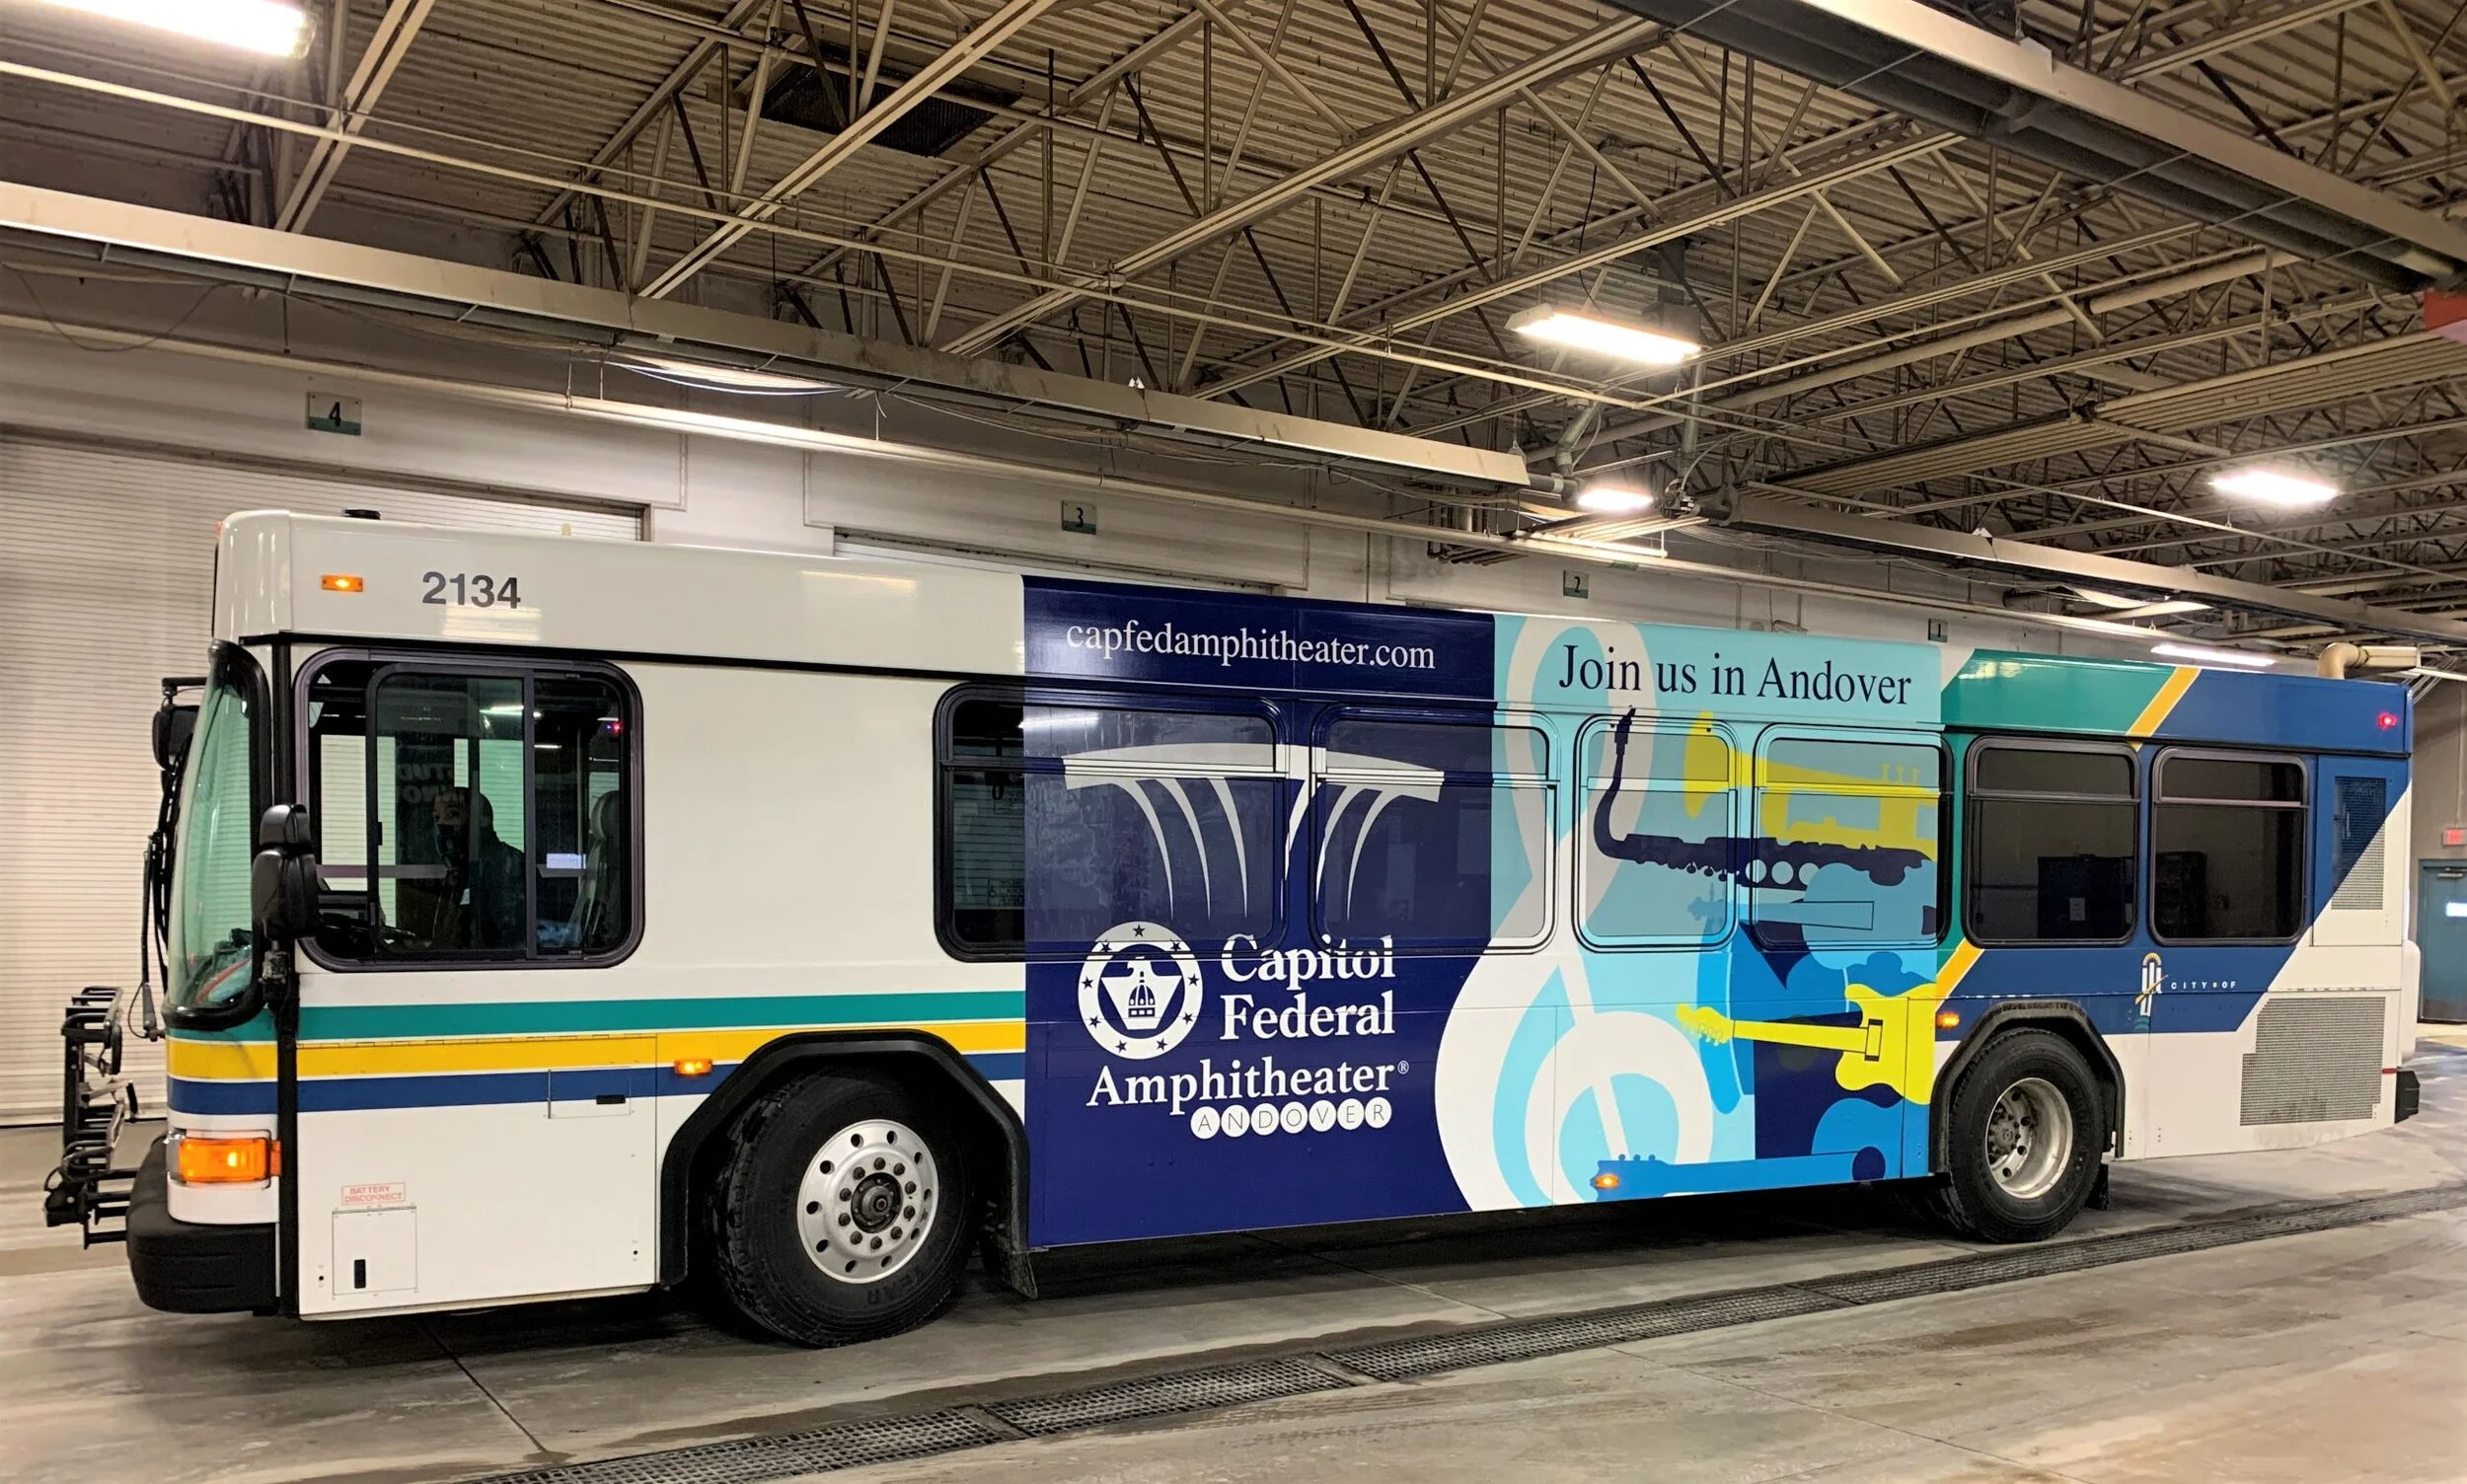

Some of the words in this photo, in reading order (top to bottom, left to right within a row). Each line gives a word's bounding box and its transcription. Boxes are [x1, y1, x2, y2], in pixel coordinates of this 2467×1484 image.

[328, 402, 342, 427] 4
[1076, 506, 1084, 528] 3
[421, 570, 521, 610] 2134
[1574, 575, 1581, 593] 2
[1066, 620, 1436, 670] capfedamphitheater.com
[1558, 644, 1642, 692] Join
[1657, 662, 1696, 695] us
[1711, 652, 1746, 697] in
[1757, 656, 1912, 705] Andover
[1220, 932, 1396, 992] Capitol
[2170, 981, 2207, 991] CITY
[2221, 981, 2237, 990] OF
[1220, 990, 1396, 1040] Federal
[1195, 1102, 1387, 1134] ANDOVER
[344, 1192, 403, 1203] DISCONNECT
[349, 1186, 391, 1195] BATTERY
